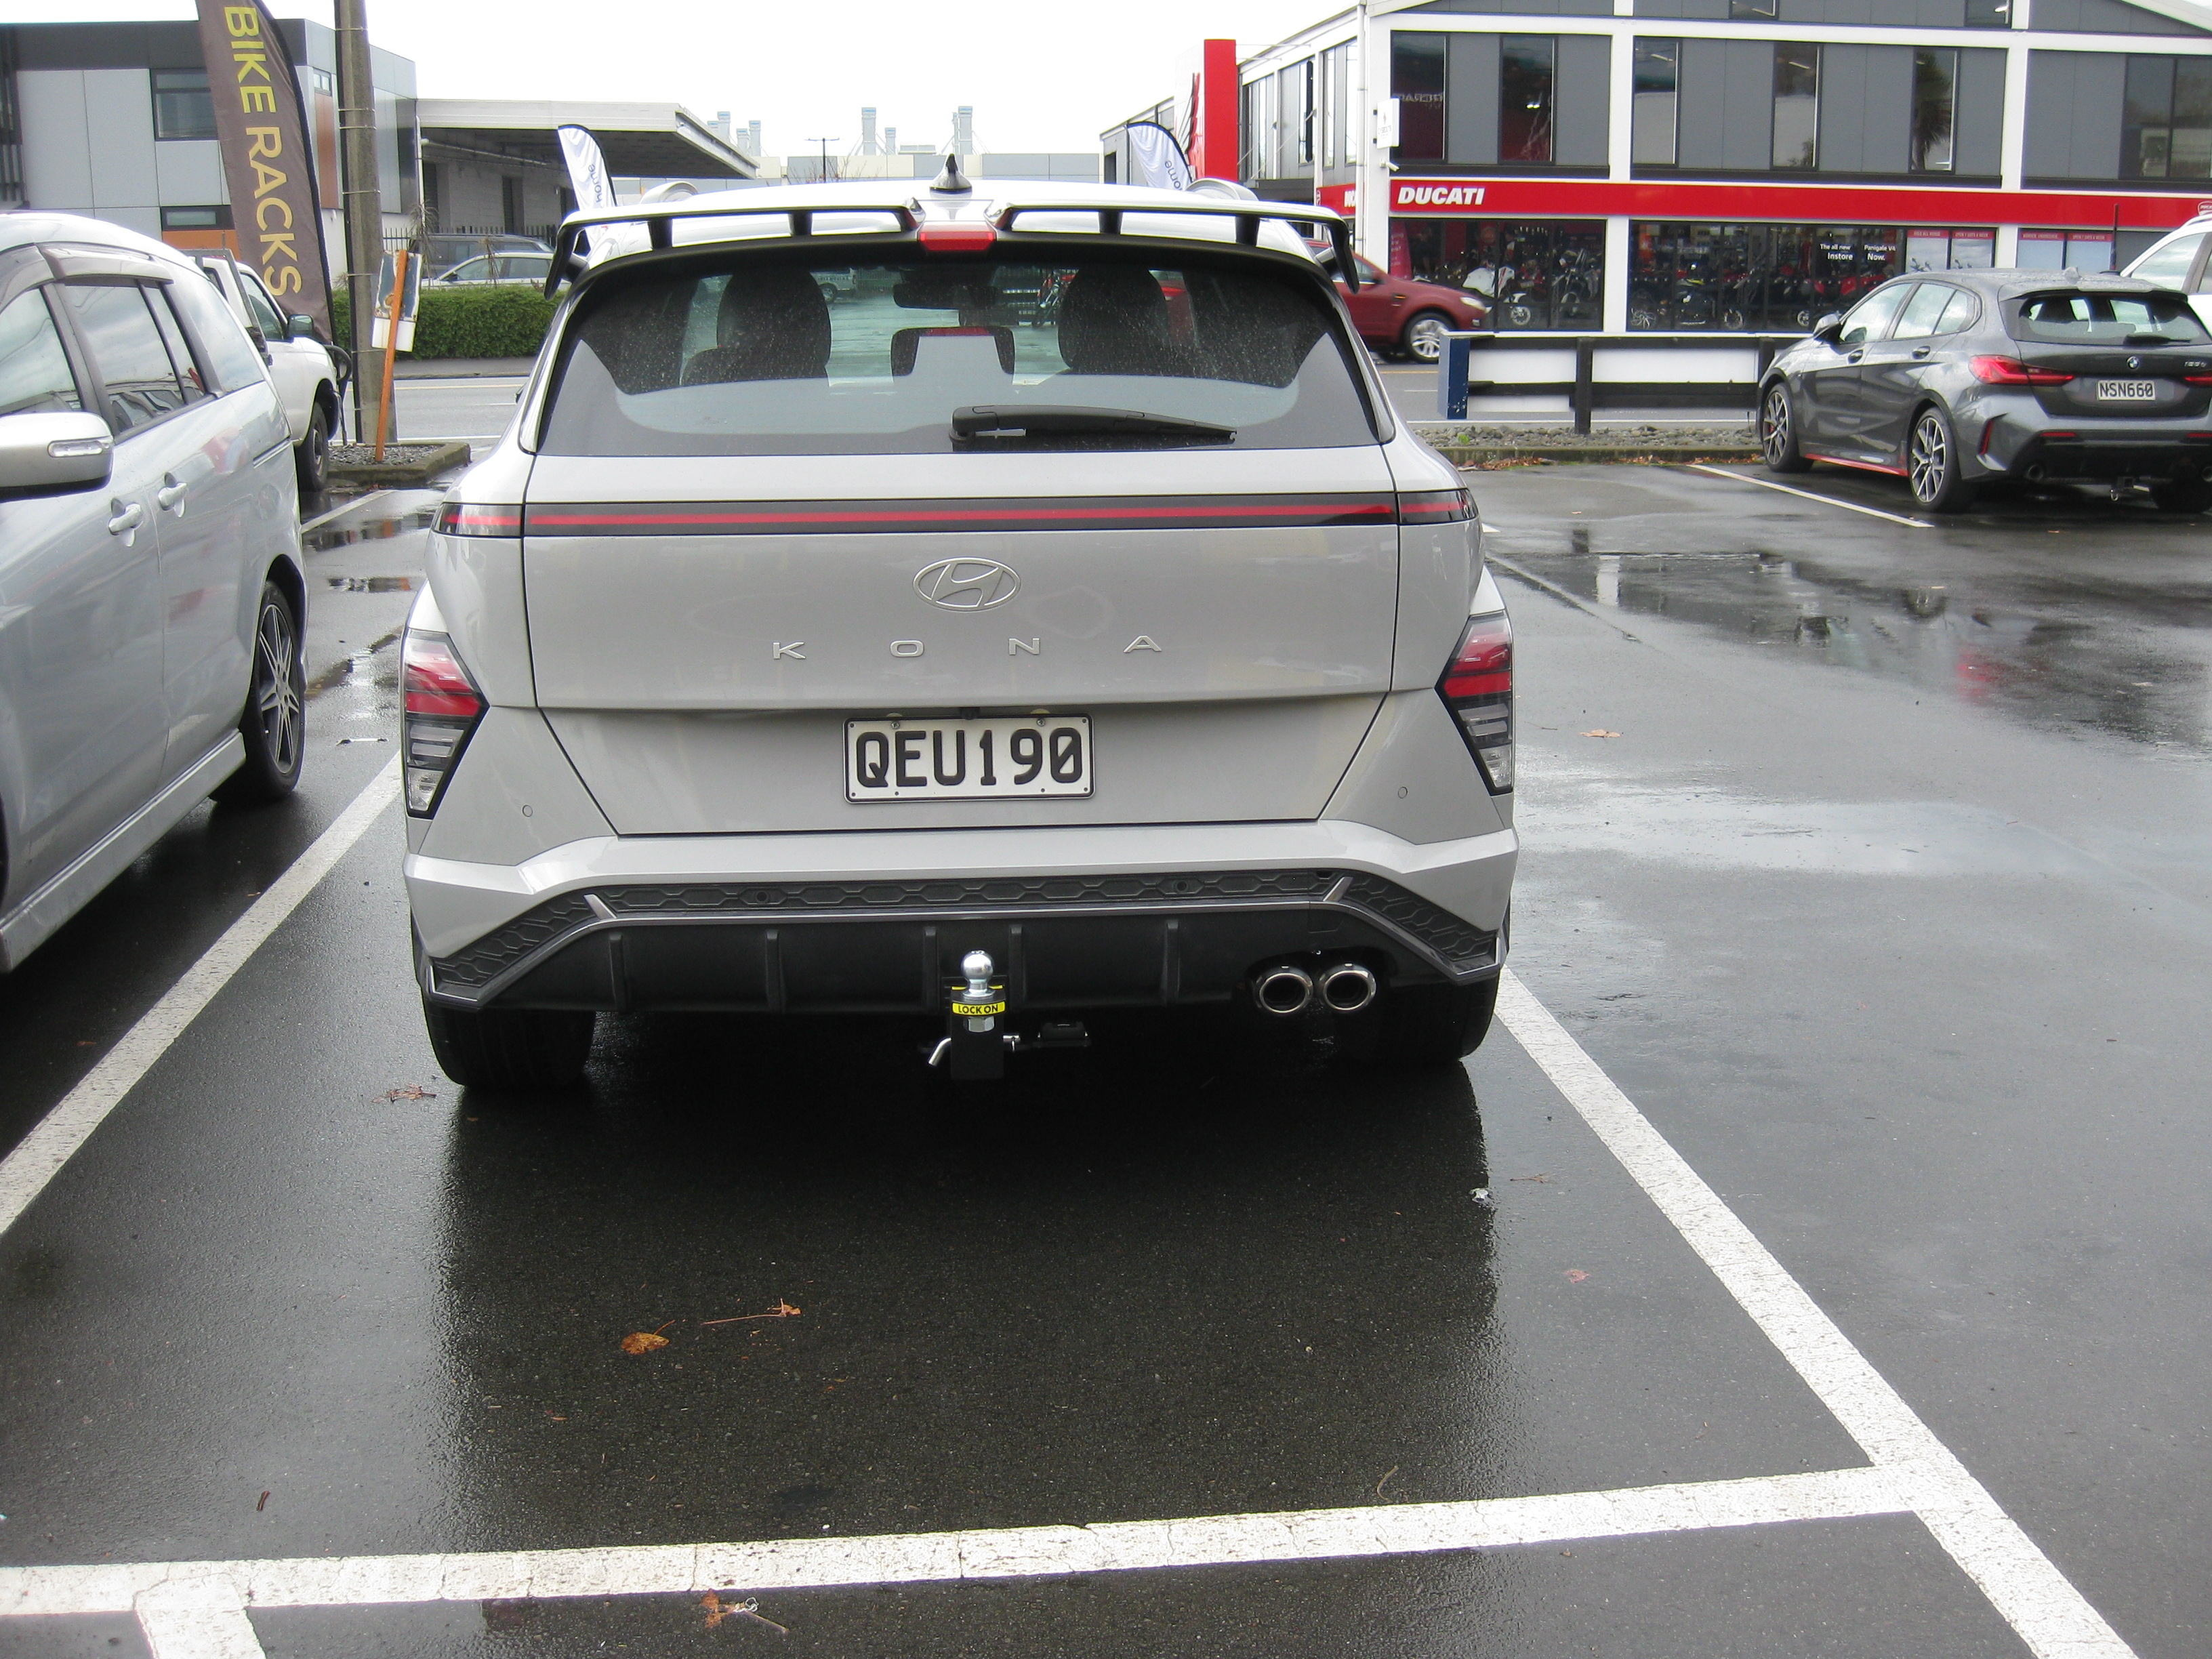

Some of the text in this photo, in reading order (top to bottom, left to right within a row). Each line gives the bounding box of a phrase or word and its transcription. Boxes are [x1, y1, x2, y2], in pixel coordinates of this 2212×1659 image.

[224, 6, 302, 297] BIKE RACKS
[1164, 160, 1183, 190] ome
[1397, 186, 1486, 205] DUCATI
[1827, 252, 1853, 260] Instore
[2100, 382, 2153, 397] NSN660
[773, 635, 1162, 660] KONA
[855, 727, 1083, 787] QEU190
[958, 1004, 999, 1015] LOCK ON
